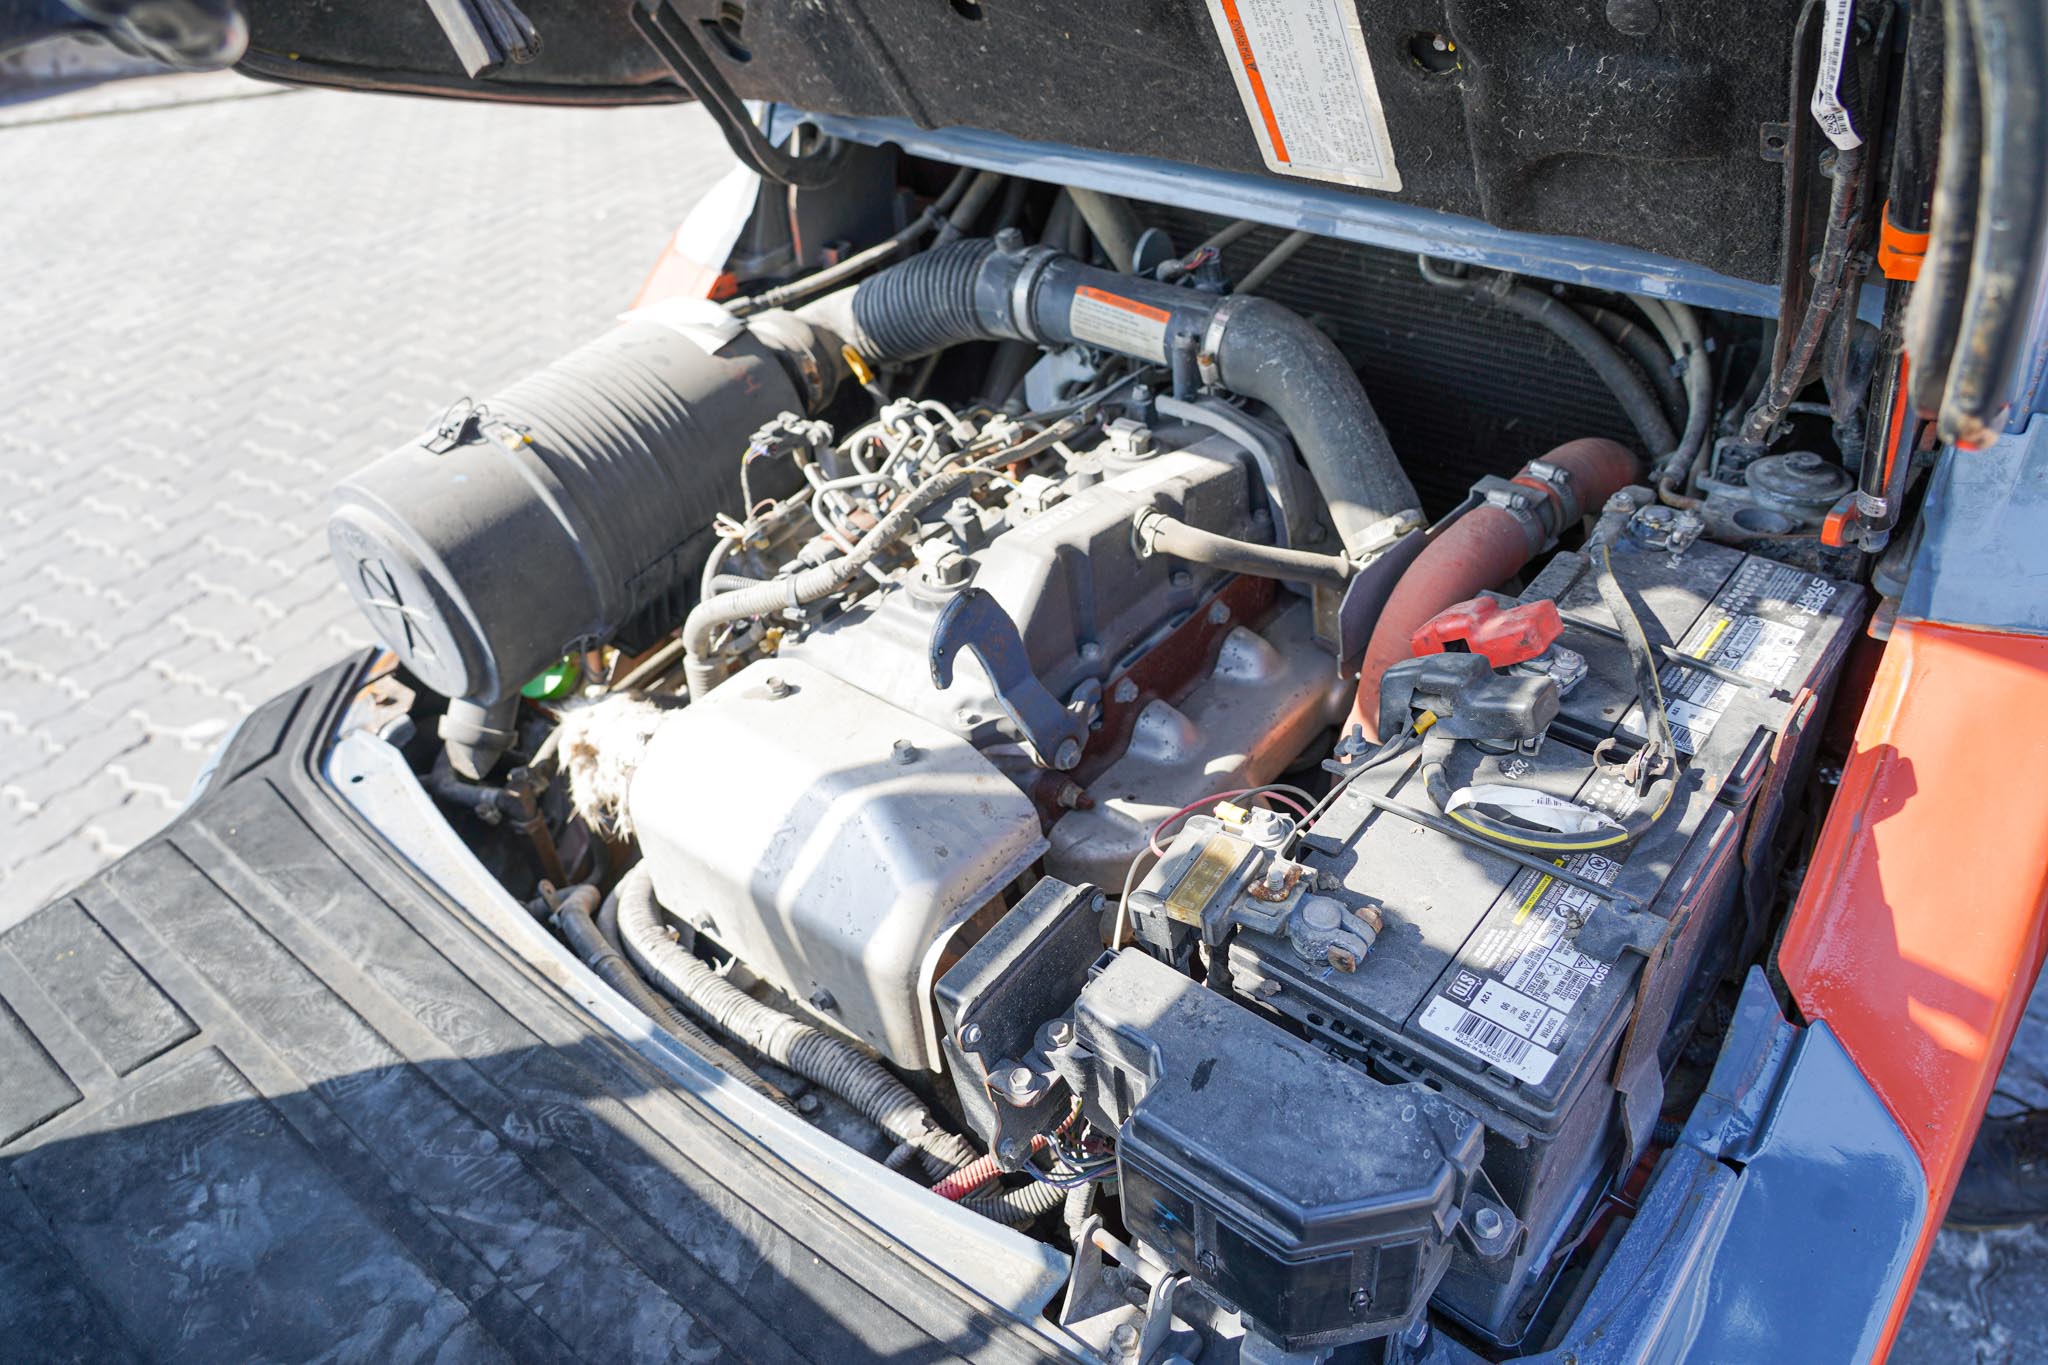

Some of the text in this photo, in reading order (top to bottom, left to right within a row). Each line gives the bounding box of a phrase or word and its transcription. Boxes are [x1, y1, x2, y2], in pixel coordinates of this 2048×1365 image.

[1229, 18, 1253, 60] WARNING
[1021, 497, 1100, 538] TOYOTA
[1790, 576, 1830, 613] START
[1804, 584, 1837, 616] SUPER
[1450, 972, 1477, 998] STD
[1532, 969, 1546, 984] HELP
[1557, 971, 1581, 1001] IMMEDIATELY
[1588, 959, 1612, 988] ISON
[1478, 989, 1493, 1005] 12V
[1531, 977, 1550, 999] MEDICAL
[1539, 991, 1550, 1002] GET
[1566, 987, 1580, 1001] EYES
[1498, 1000, 1511, 1012] 90
[1516, 1008, 1531, 1023] 550
[1530, 1007, 1541, 1019] CCA
[1537, 1015, 1559, 1040] 35PRM
[1453, 1036, 1472, 1048] MADE
[1477, 1048, 1501, 1063] MEXICO
